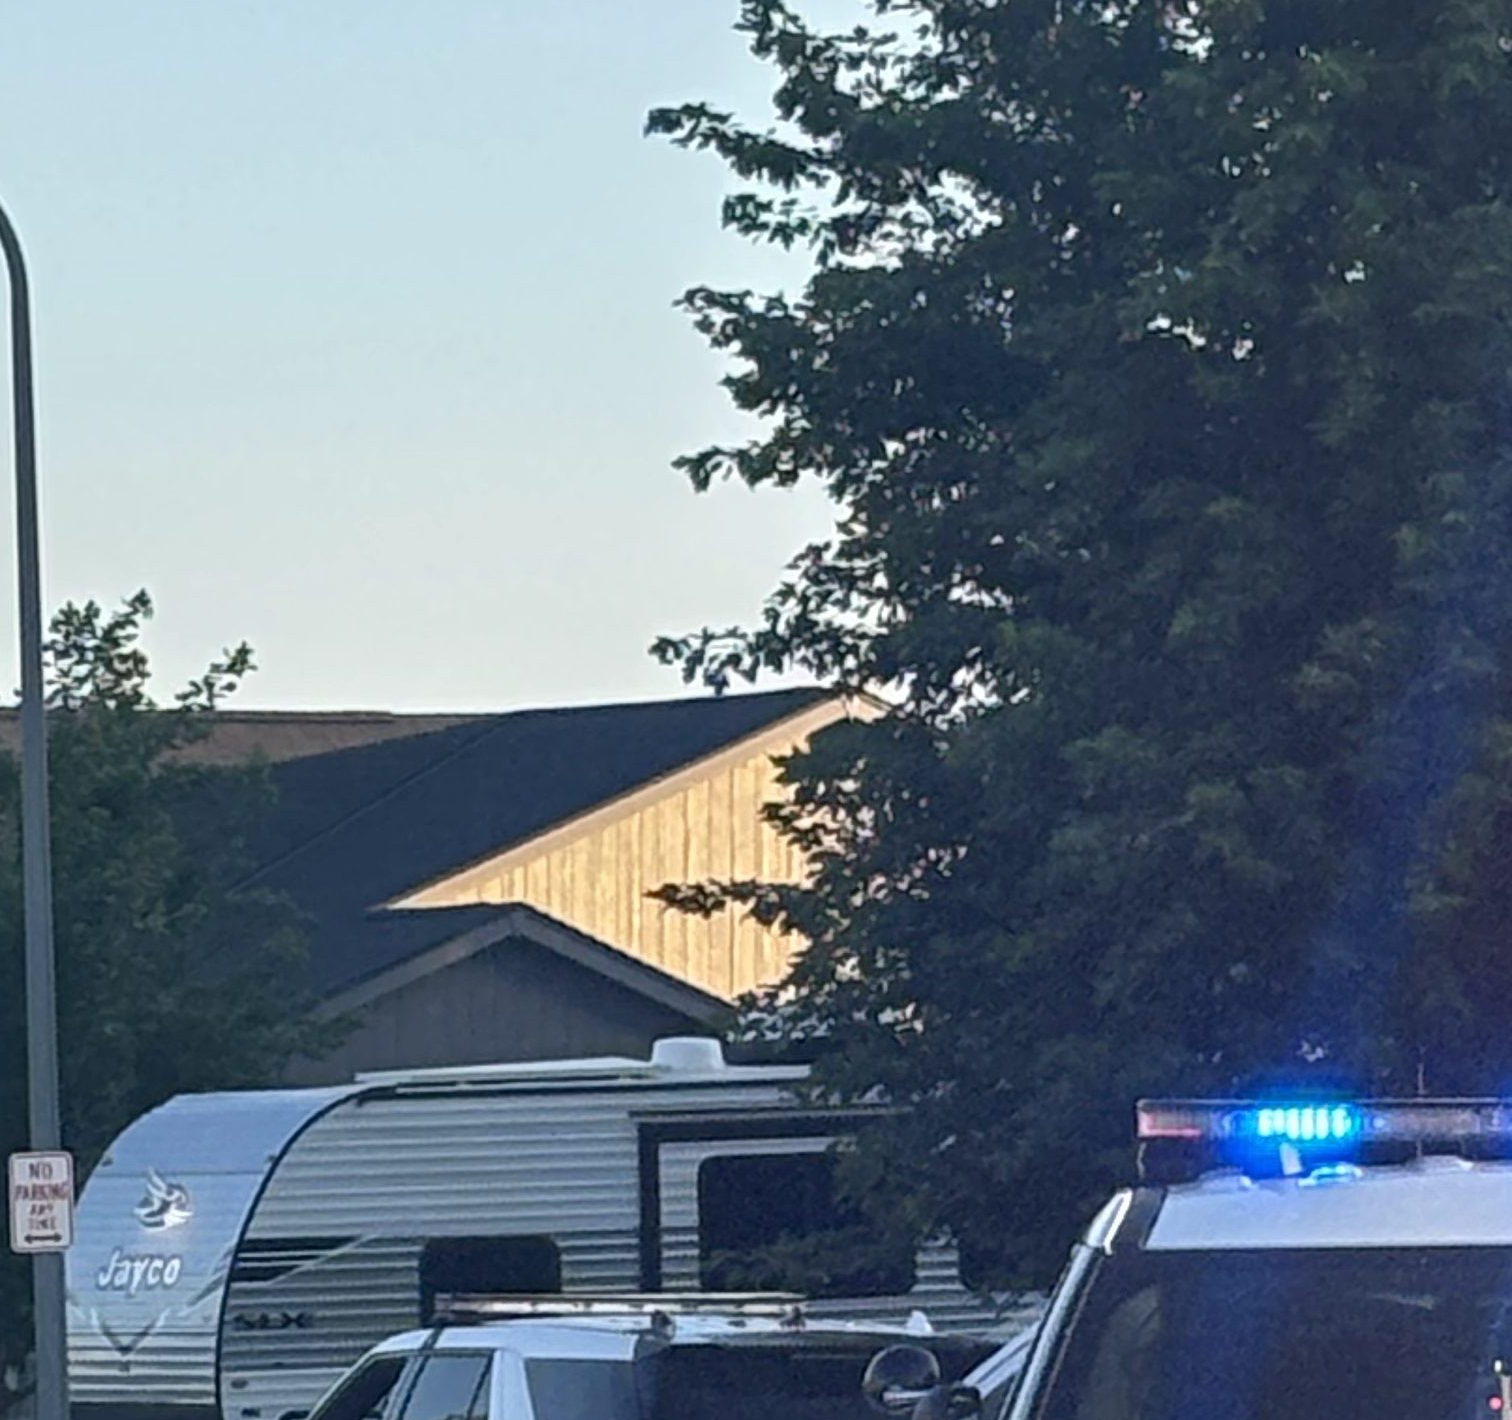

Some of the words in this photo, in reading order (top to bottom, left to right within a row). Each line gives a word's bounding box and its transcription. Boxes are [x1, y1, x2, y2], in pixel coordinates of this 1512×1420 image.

[29, 1161, 53, 1180] NO
[15, 1181, 68, 1200] PARKING
[98, 1249, 180, 1296] Jayco
